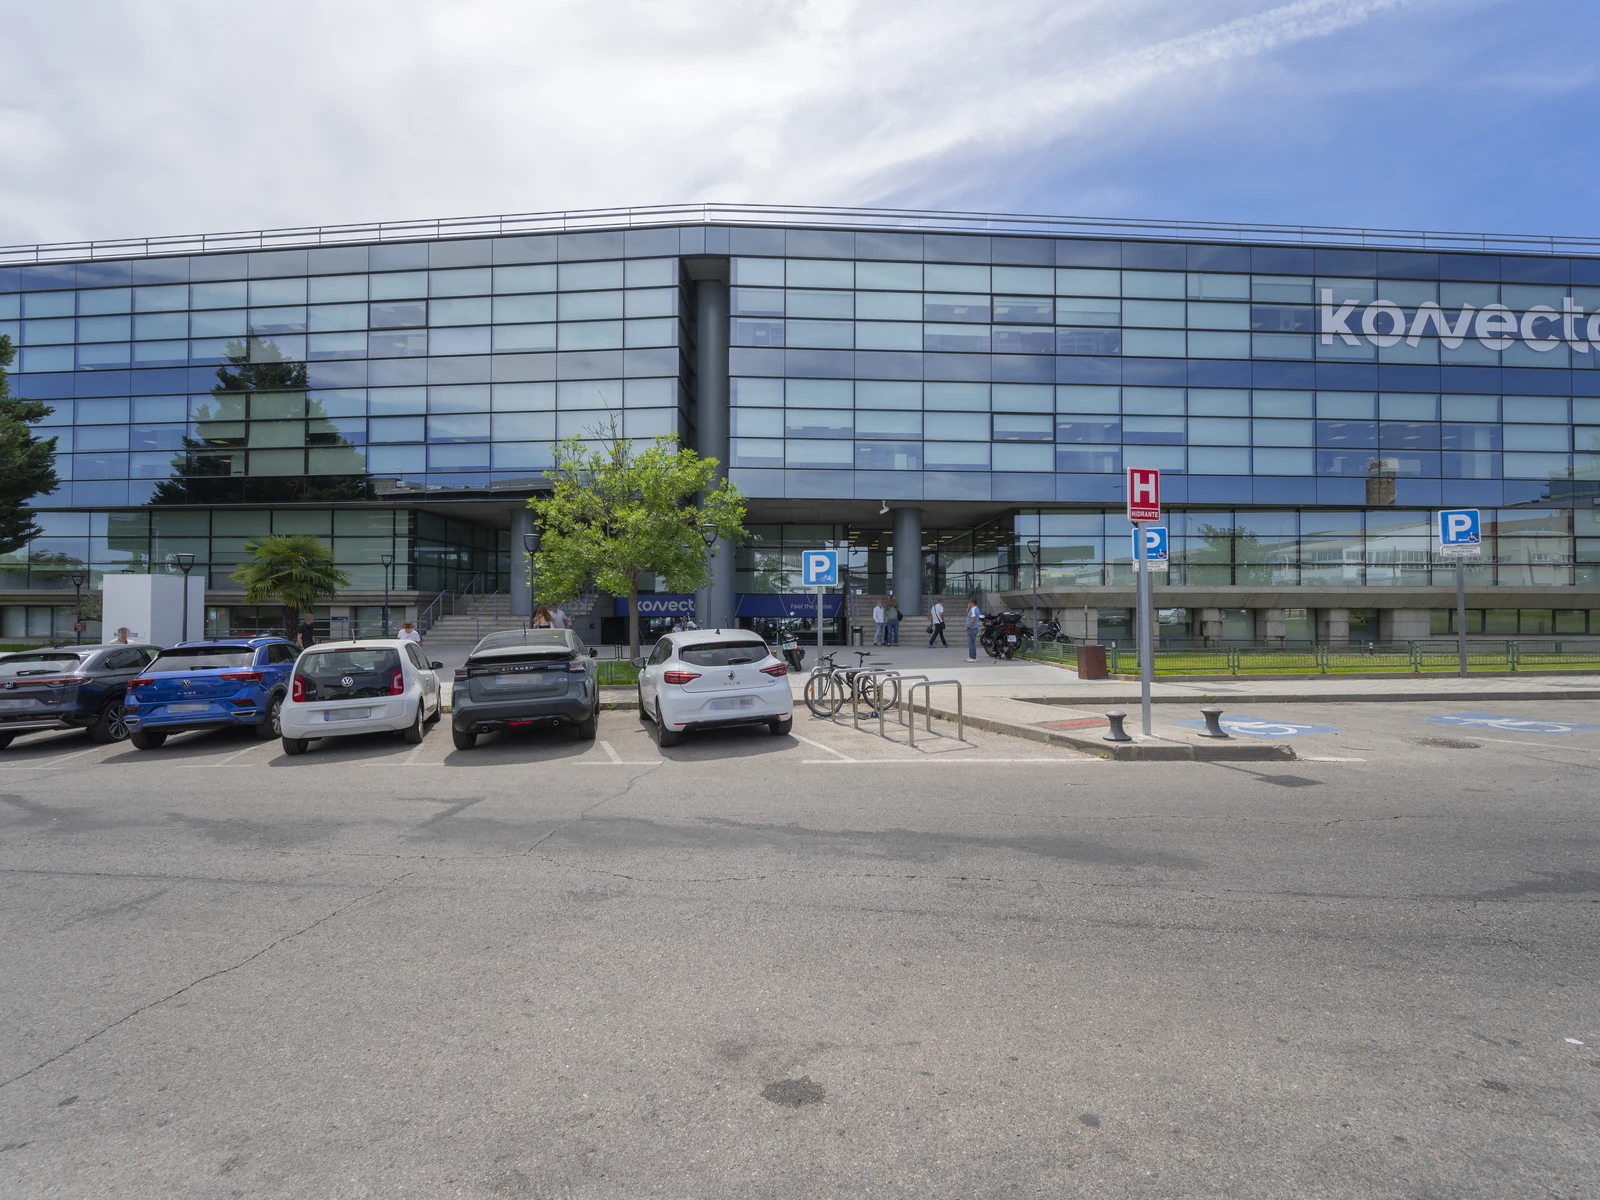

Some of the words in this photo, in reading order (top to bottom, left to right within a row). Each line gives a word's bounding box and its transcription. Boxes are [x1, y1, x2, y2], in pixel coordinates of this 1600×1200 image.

[1133, 472, 1156, 504] H
[1131, 510, 1159, 518] HIDRANTE
[1447, 514, 1472, 541] P
[809, 554, 831, 582] P
[815, 603, 834, 611] plse.
